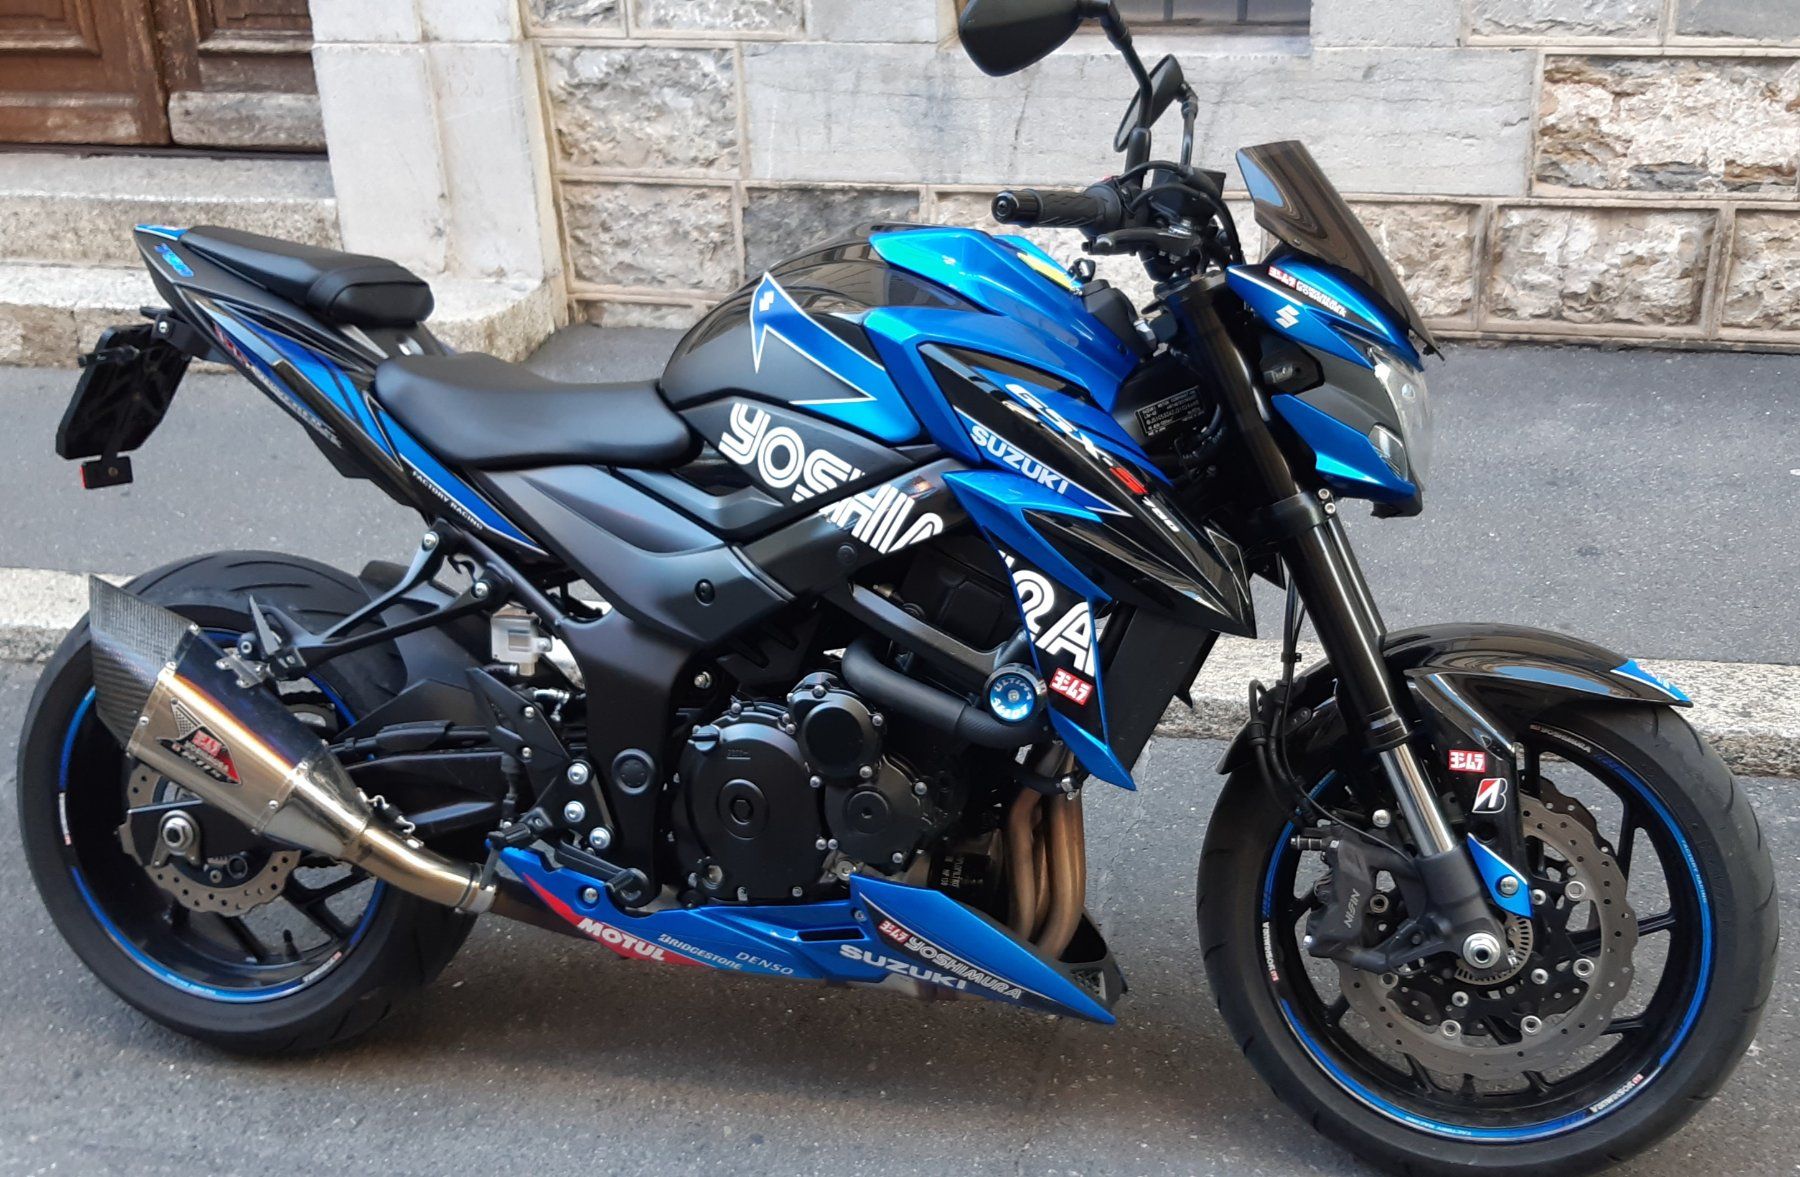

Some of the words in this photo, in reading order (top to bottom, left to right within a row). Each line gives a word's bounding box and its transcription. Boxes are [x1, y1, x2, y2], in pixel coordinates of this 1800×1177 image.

[969, 425, 1069, 495] SUZUKI
[412, 470, 449, 502] FACTORY
[450, 502, 483, 530] RACING
[576, 917, 667, 962] MOTUL
[657, 933, 744, 970] BRIDGESTONE
[735, 951, 795, 976] DENSO
[839, 943, 967, 990] SUZUKI
[904, 936, 1024, 1000] YOSHIMURA
